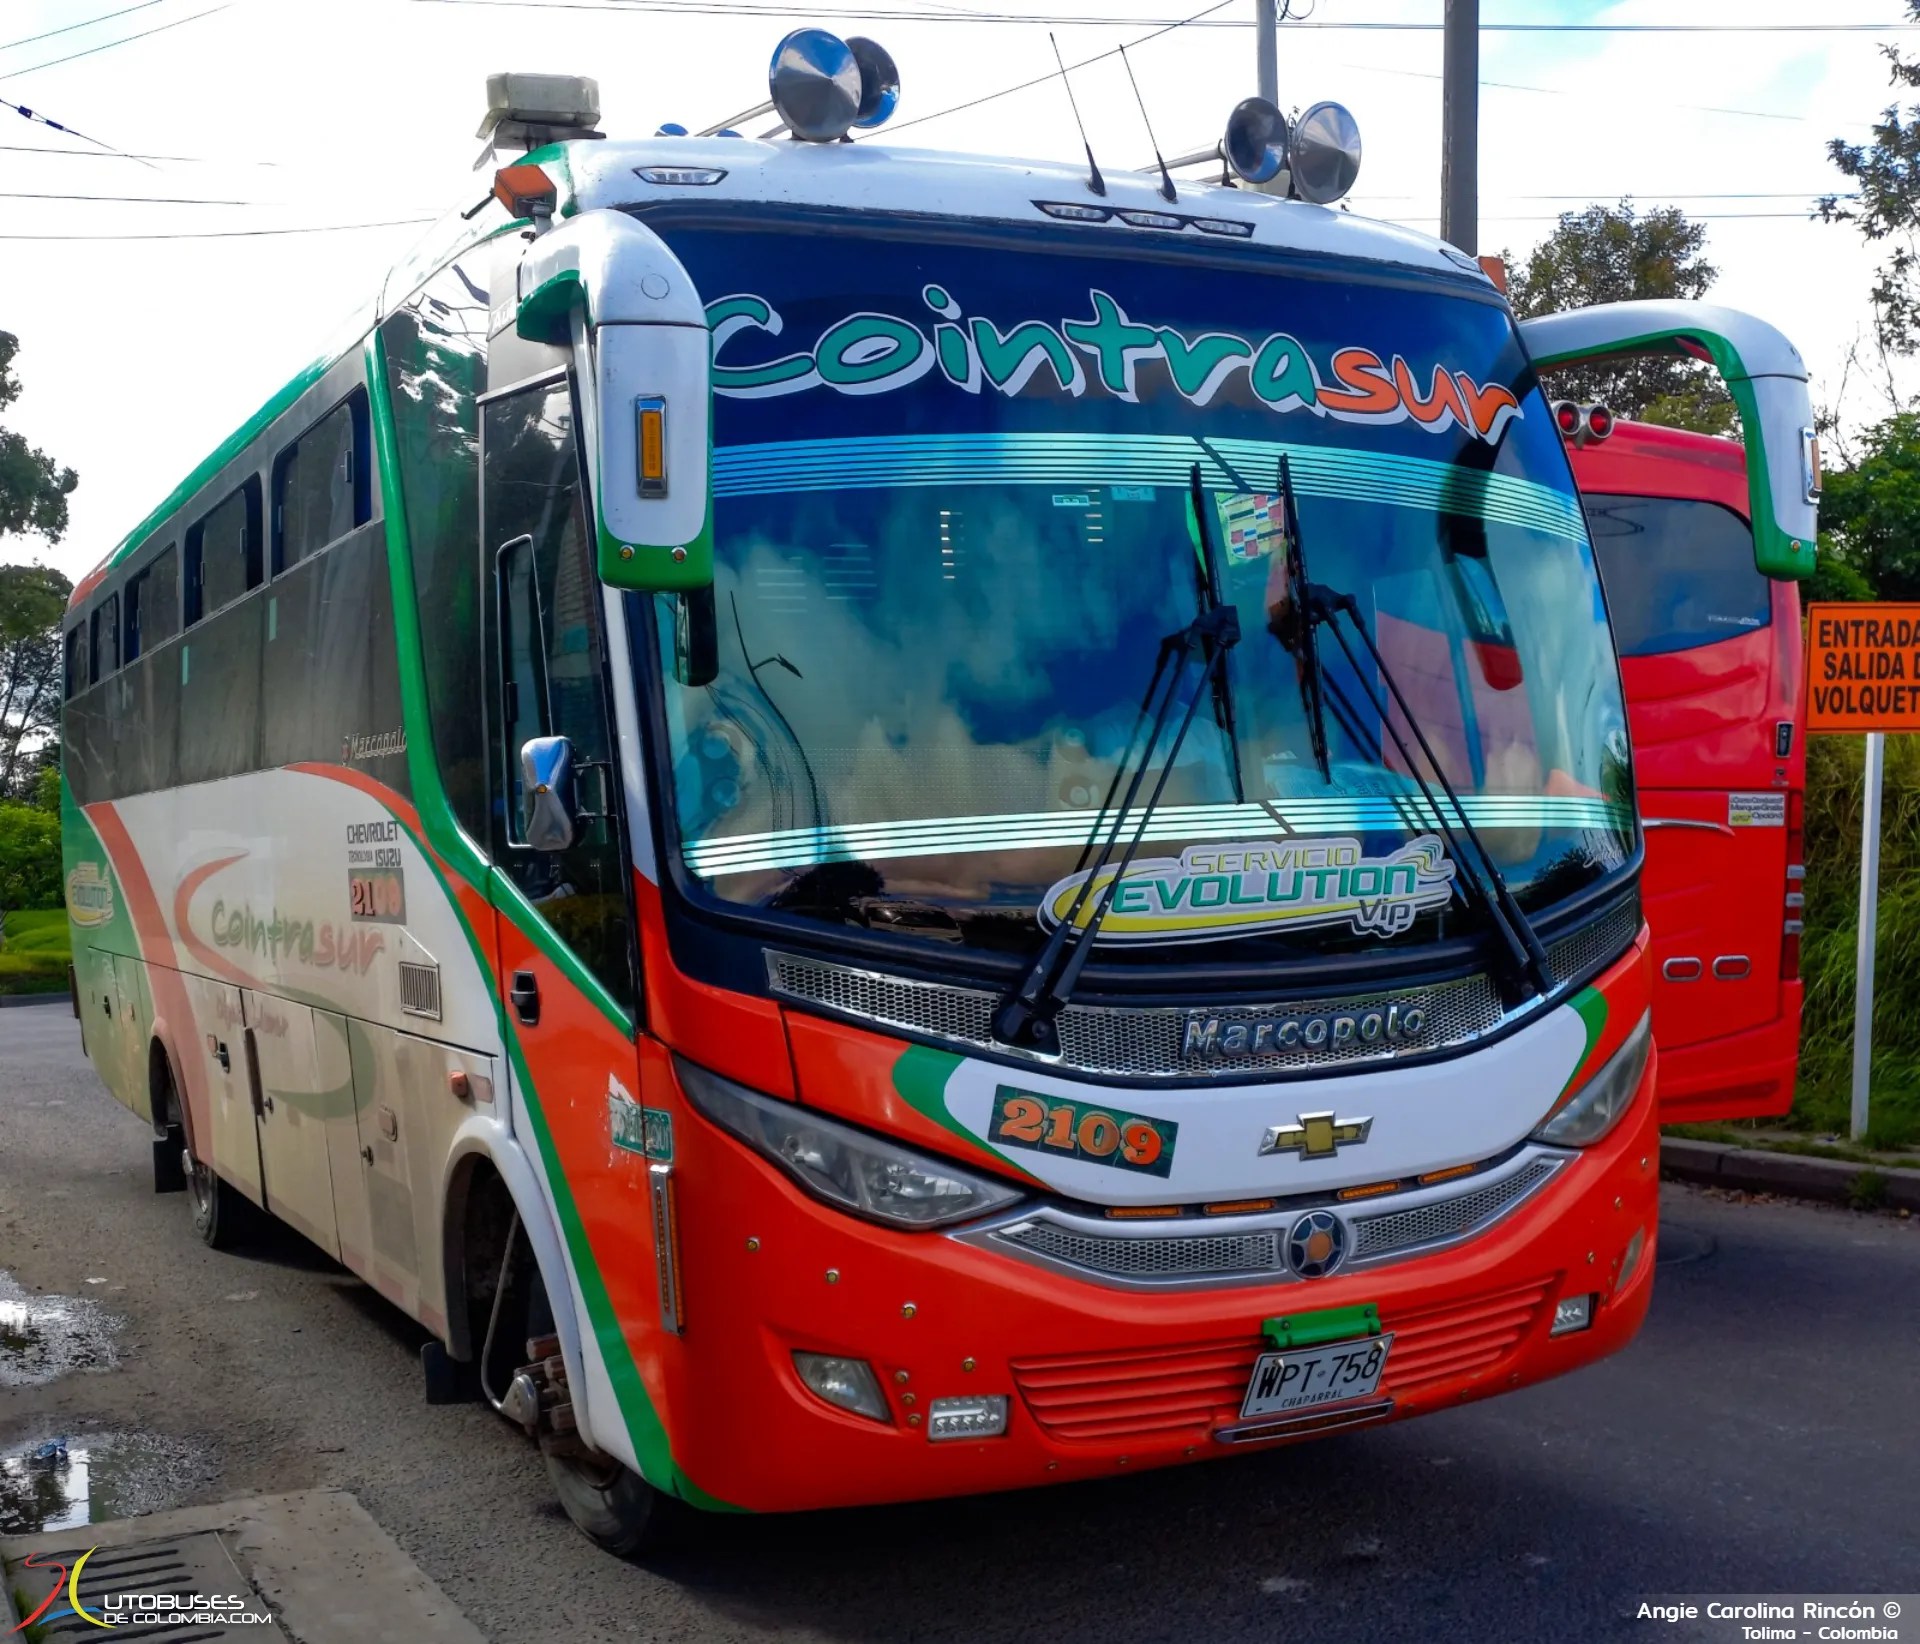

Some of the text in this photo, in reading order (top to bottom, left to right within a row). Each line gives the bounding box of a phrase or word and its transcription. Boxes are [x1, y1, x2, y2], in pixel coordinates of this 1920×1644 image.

[705, 284, 1525, 446] Cointrasur
[1819, 620, 1920, 648] ENTRADA
[1824, 652, 1905, 680] SALIDA
[347, 821, 399, 844] CHEVROLET
[375, 848, 402, 867] ISUZU
[1190, 847, 1358, 876] SERVICIO
[1111, 864, 1416, 914] EVOLUTION
[212, 900, 384, 976] Cointrasur
[1182, 1004, 1428, 1059] Marcopolo
[1000, 1096, 1164, 1166] 2109
[1281, 1391, 1343, 1409] CHAPARRAL
